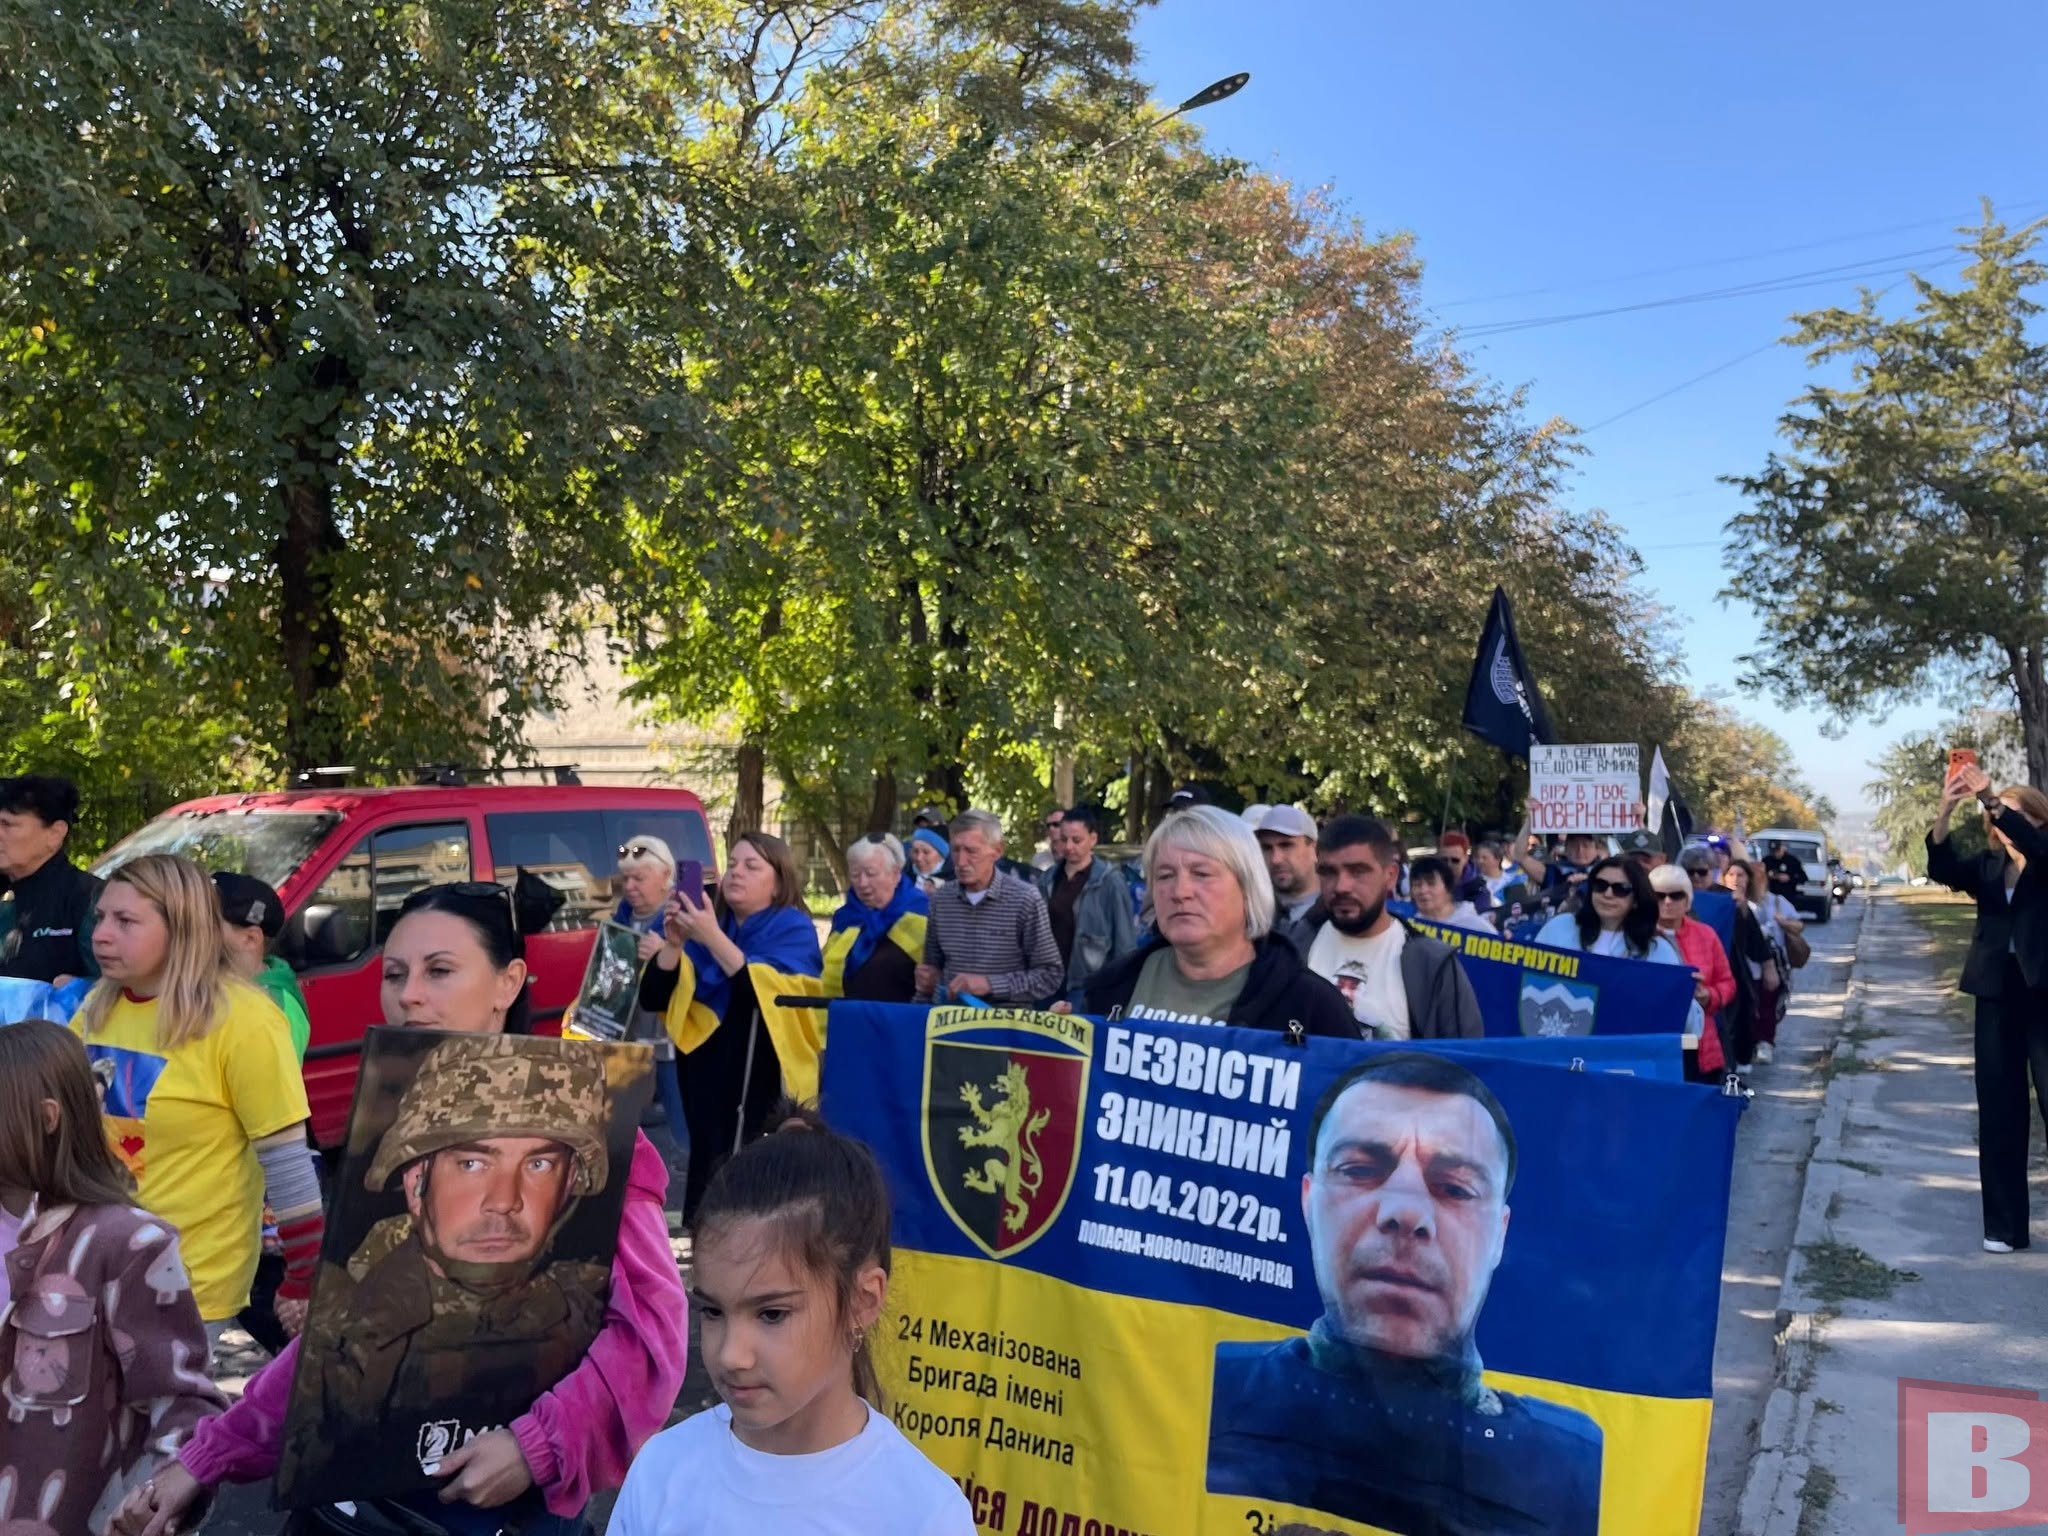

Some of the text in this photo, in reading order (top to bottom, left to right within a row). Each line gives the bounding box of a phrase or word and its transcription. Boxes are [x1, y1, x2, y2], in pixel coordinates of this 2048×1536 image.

[1540, 784, 1569, 800] ВІРУ
[1576, 784, 1586, 800] В
[1464, 934, 1579, 978] ПОВЕРНУТИ!
[934, 1006, 1086, 1044] MILITES REGUM
[1104, 1026, 1302, 1110] БЕЗВІСТИ
[1096, 1091, 1291, 1178] ЗНИКЛИЙ
[1093, 1163, 1288, 1243] 11.04.2022р.
[898, 1314, 1082, 1380] 24 Механізована
[908, 1355, 1063, 1417] Бригада імені
[893, 1401, 1075, 1466] Короля Данила
